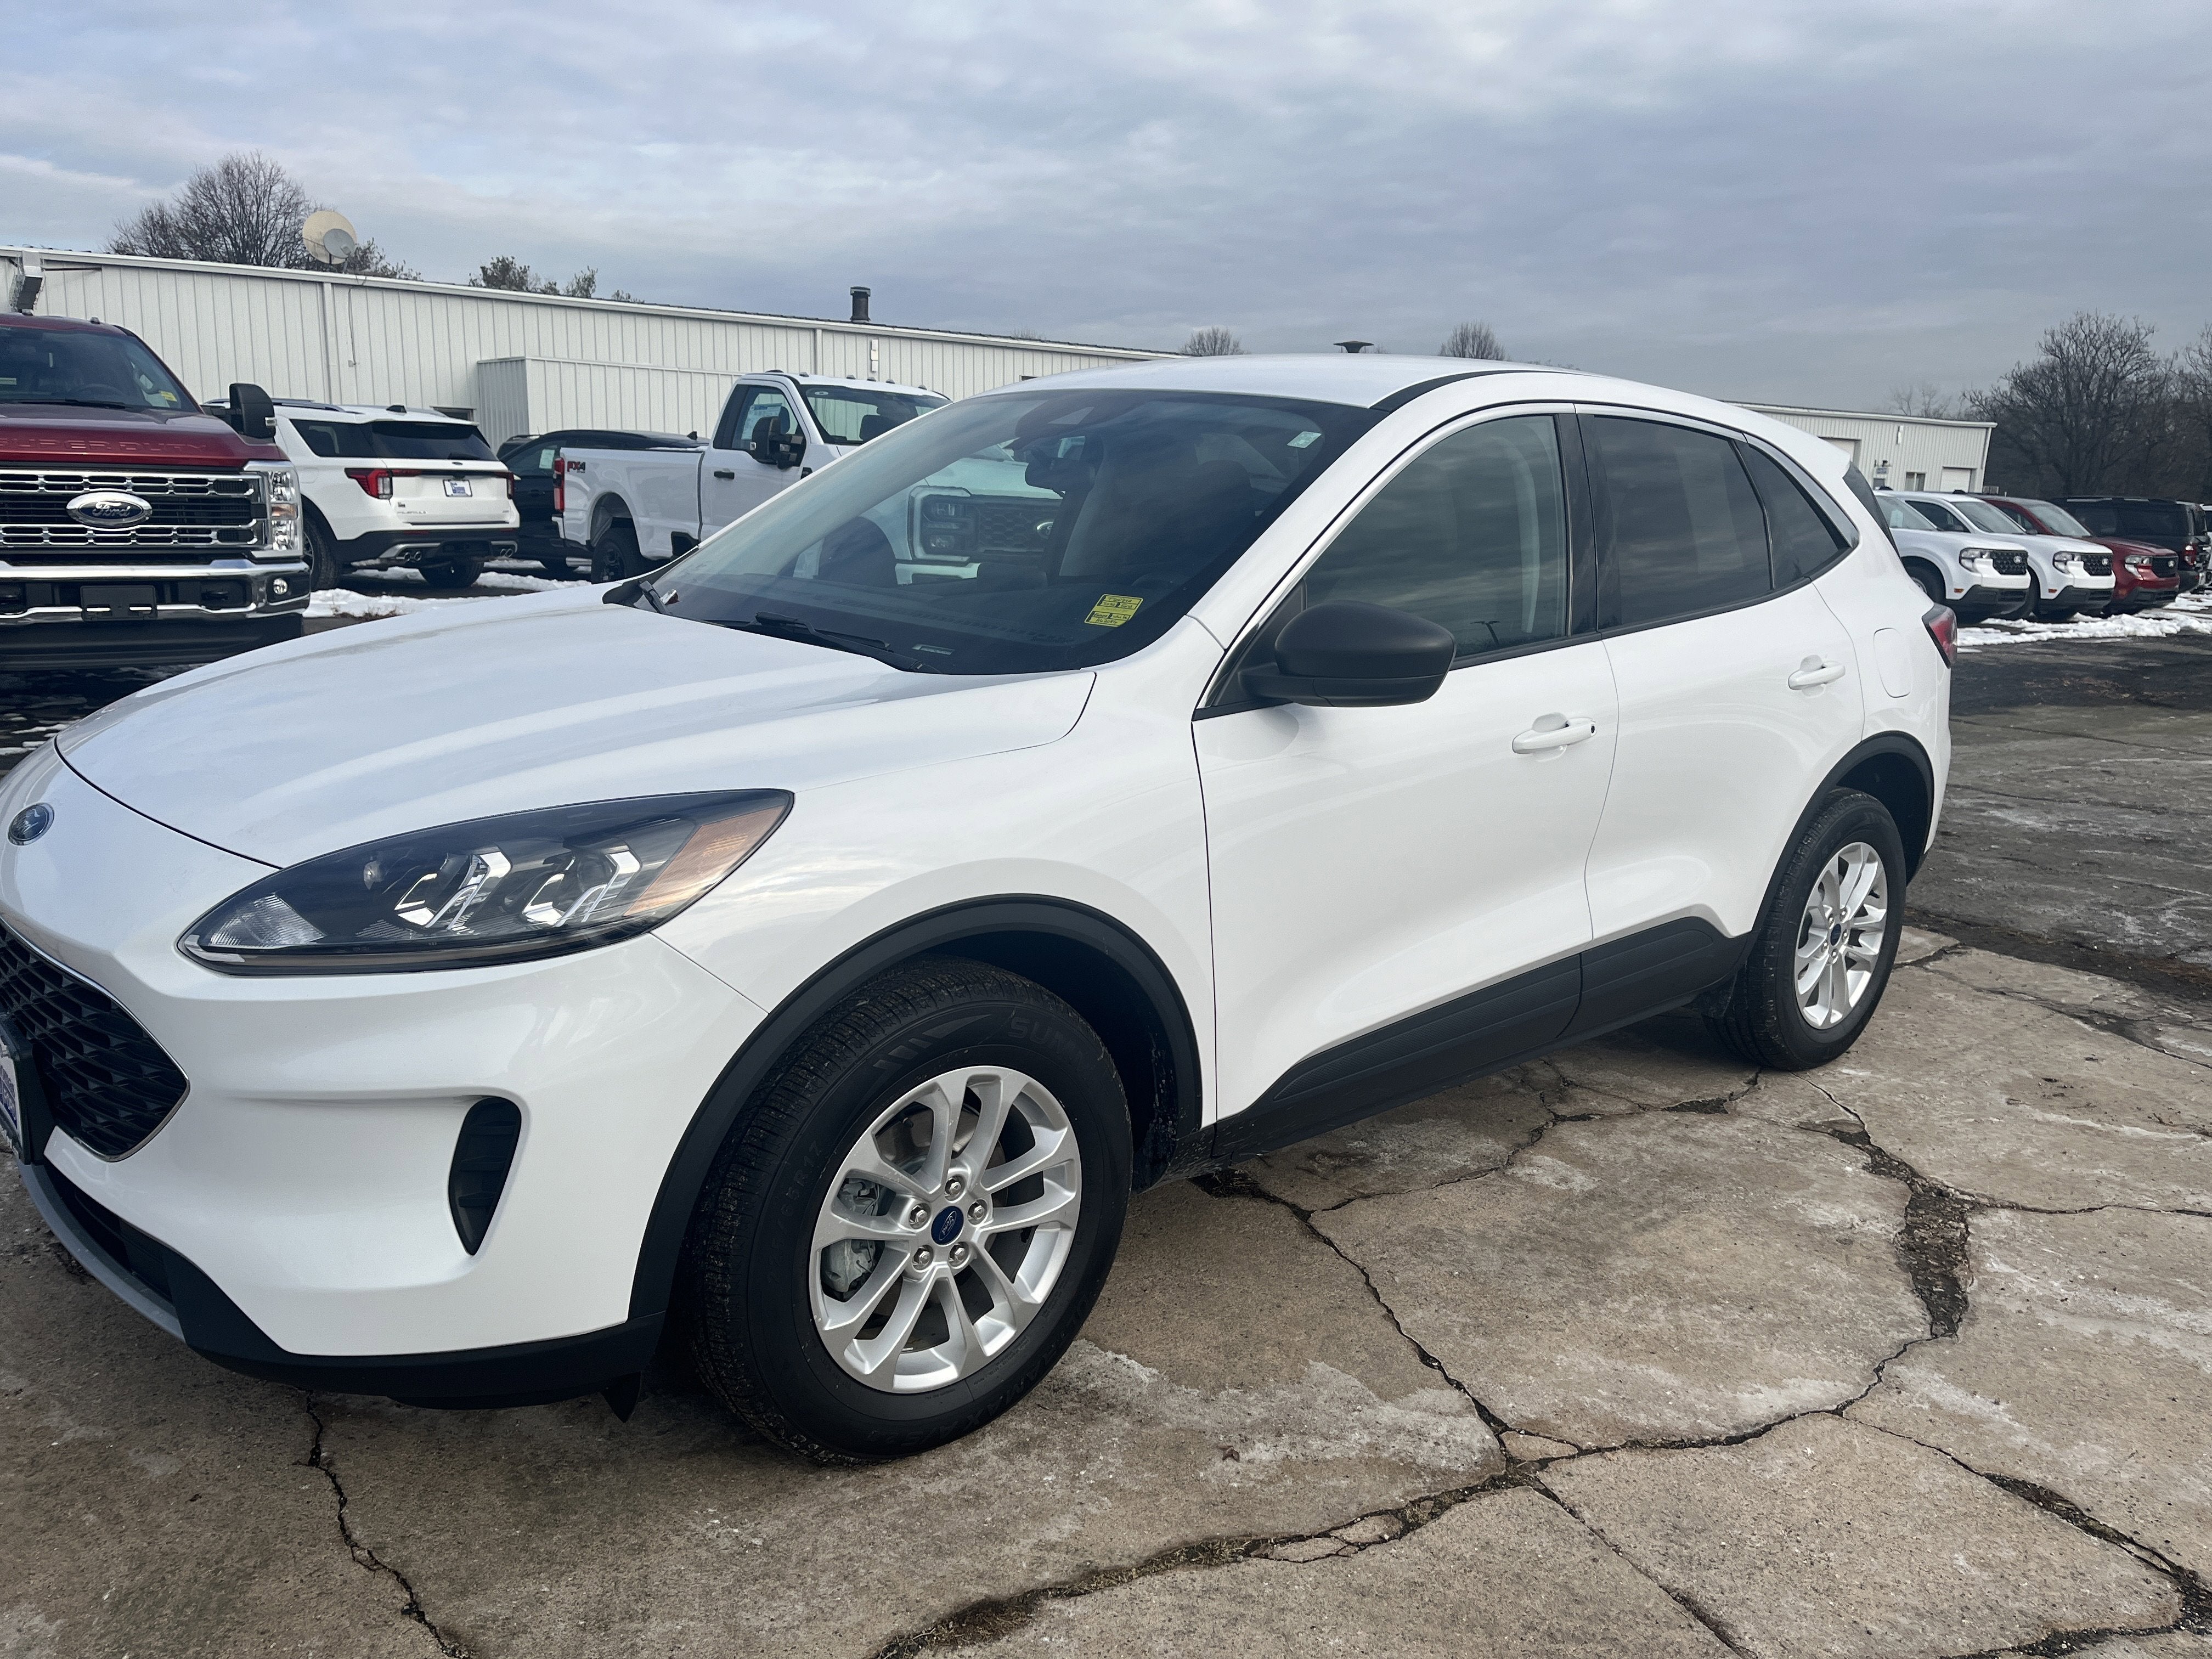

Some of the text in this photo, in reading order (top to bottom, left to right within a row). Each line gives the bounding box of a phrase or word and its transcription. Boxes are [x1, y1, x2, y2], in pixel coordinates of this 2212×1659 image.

[119, 441, 207, 452] DUTY
[567, 461, 585, 473] FX4
[92, 500, 131, 517] Ford
[941, 1215, 955, 1235] Ford
